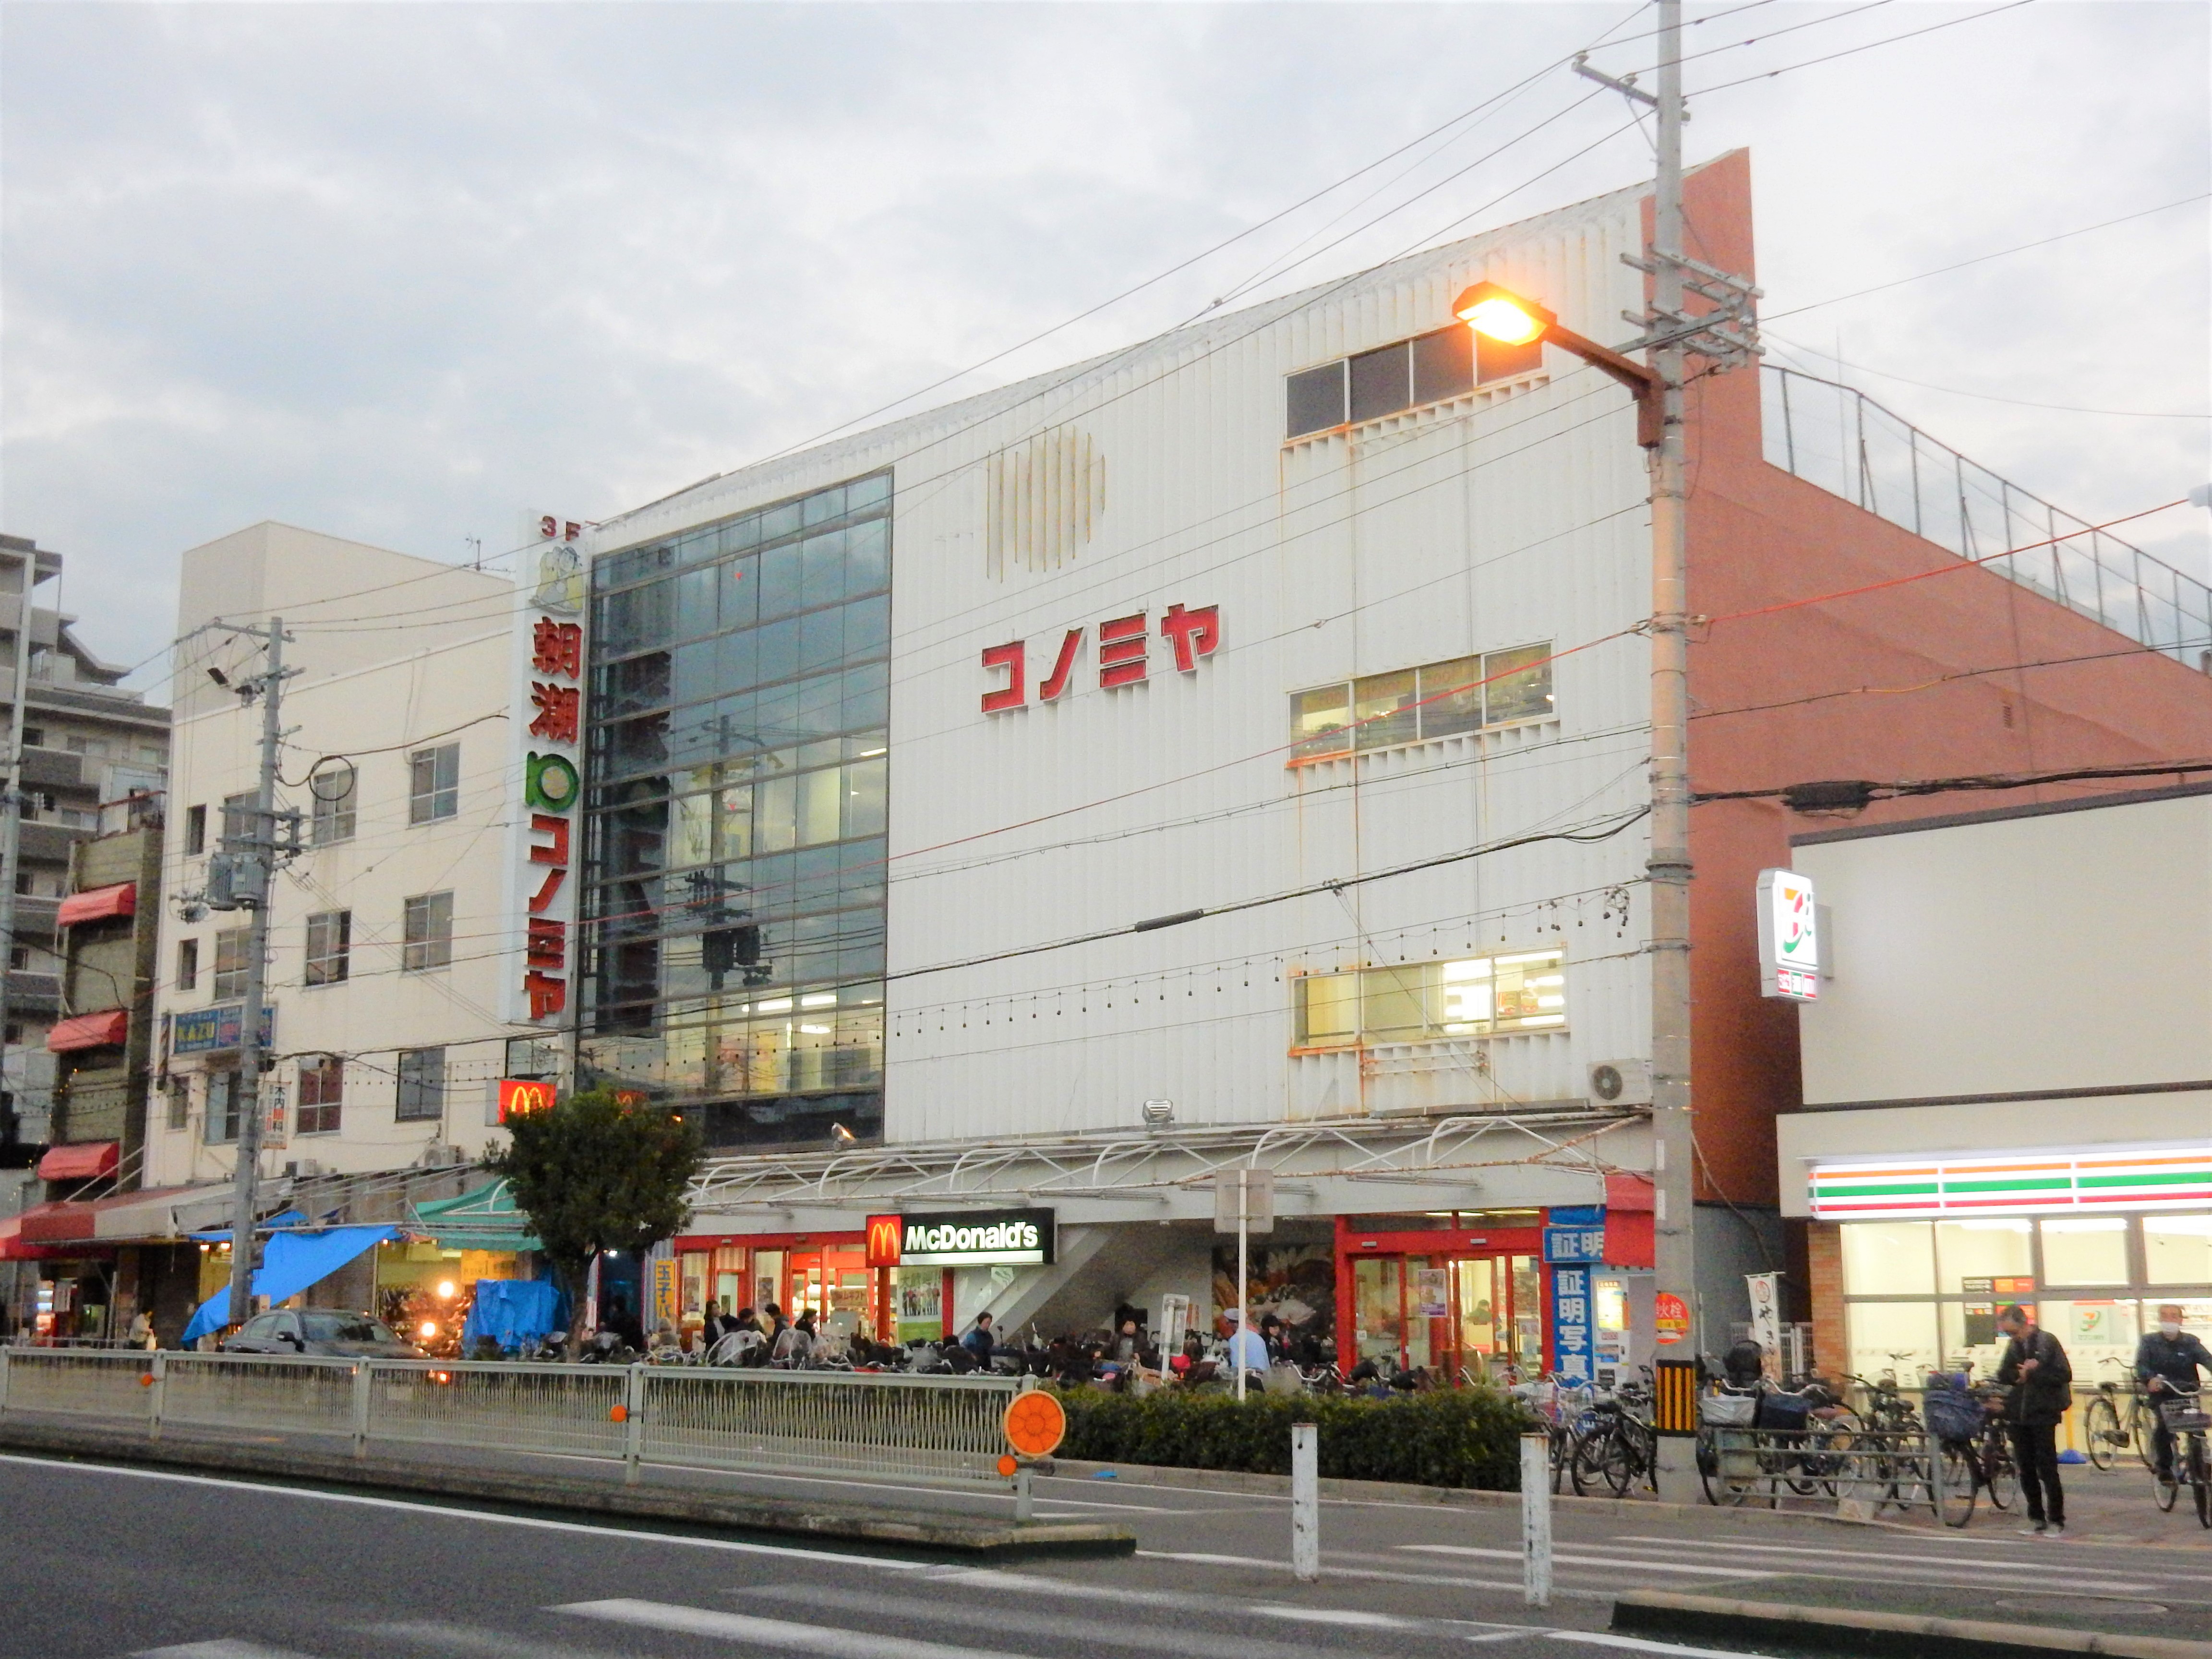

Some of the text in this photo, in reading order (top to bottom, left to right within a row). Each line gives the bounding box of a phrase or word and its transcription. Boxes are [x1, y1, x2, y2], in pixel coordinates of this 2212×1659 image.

[541, 515, 581, 542] 3F
[982, 603, 1219, 713] コノミヤ
[525, 813, 570, 1020] コノミヤ
[905, 1221, 1038, 1251] McDonald's
[1551, 1232, 1604, 1259] 証明
[1557, 1270, 1588, 1380] 証明写真
